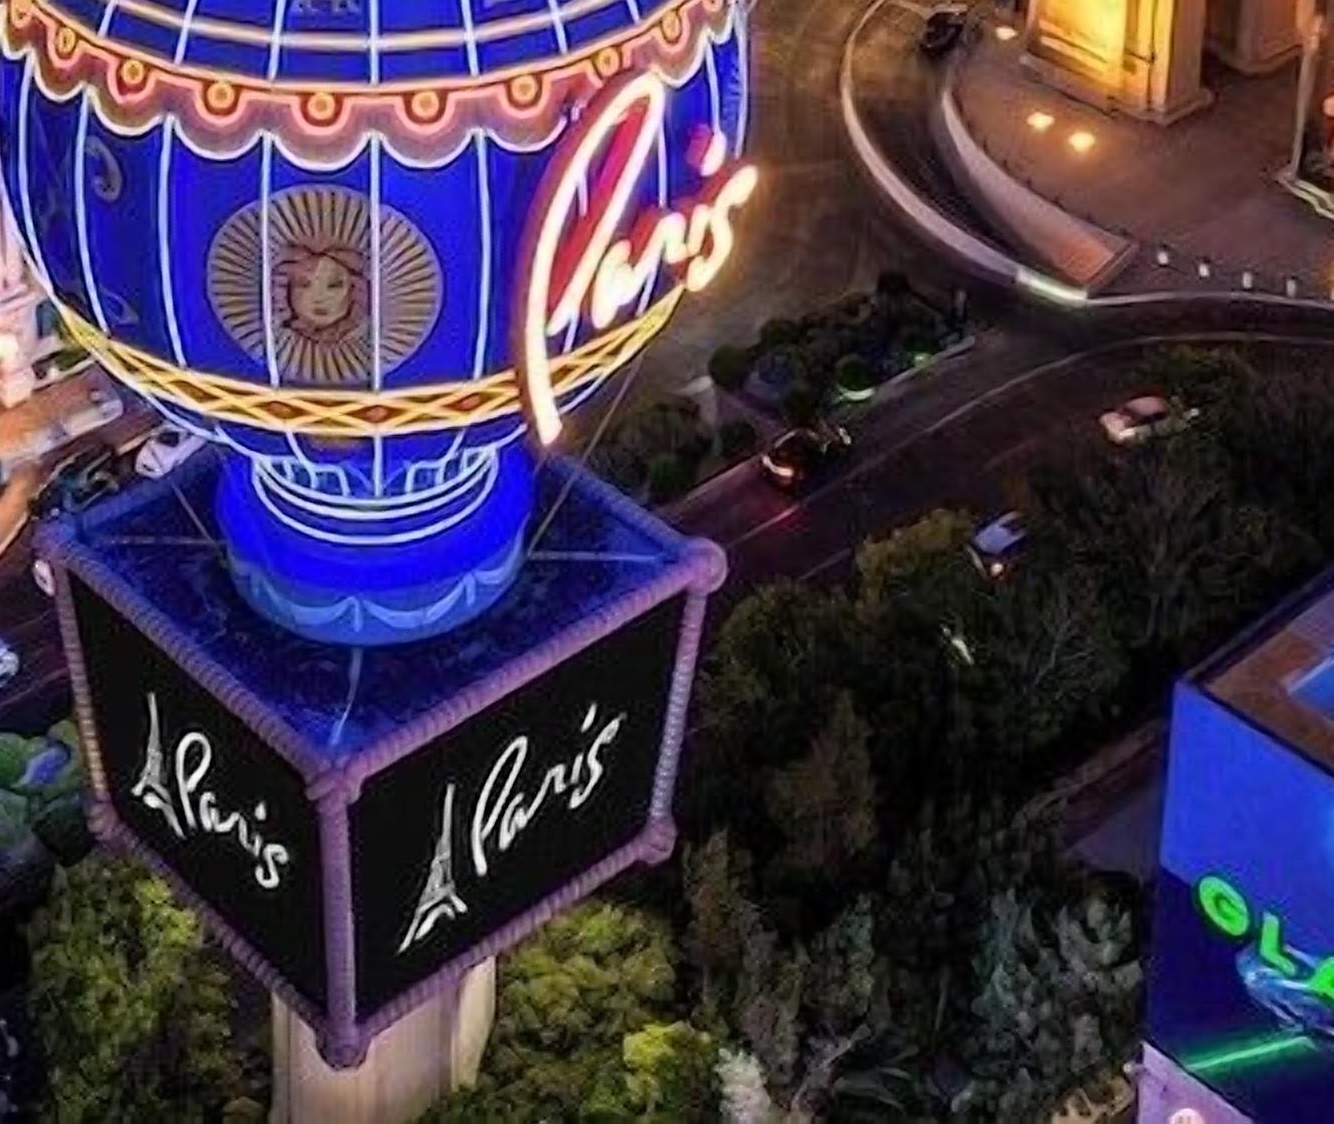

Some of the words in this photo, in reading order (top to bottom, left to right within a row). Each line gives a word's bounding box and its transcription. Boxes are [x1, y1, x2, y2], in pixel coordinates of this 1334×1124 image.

[524, 69, 758, 445] Paris
[175, 732, 289, 888] Paris
[471, 703, 627, 877] Paris
